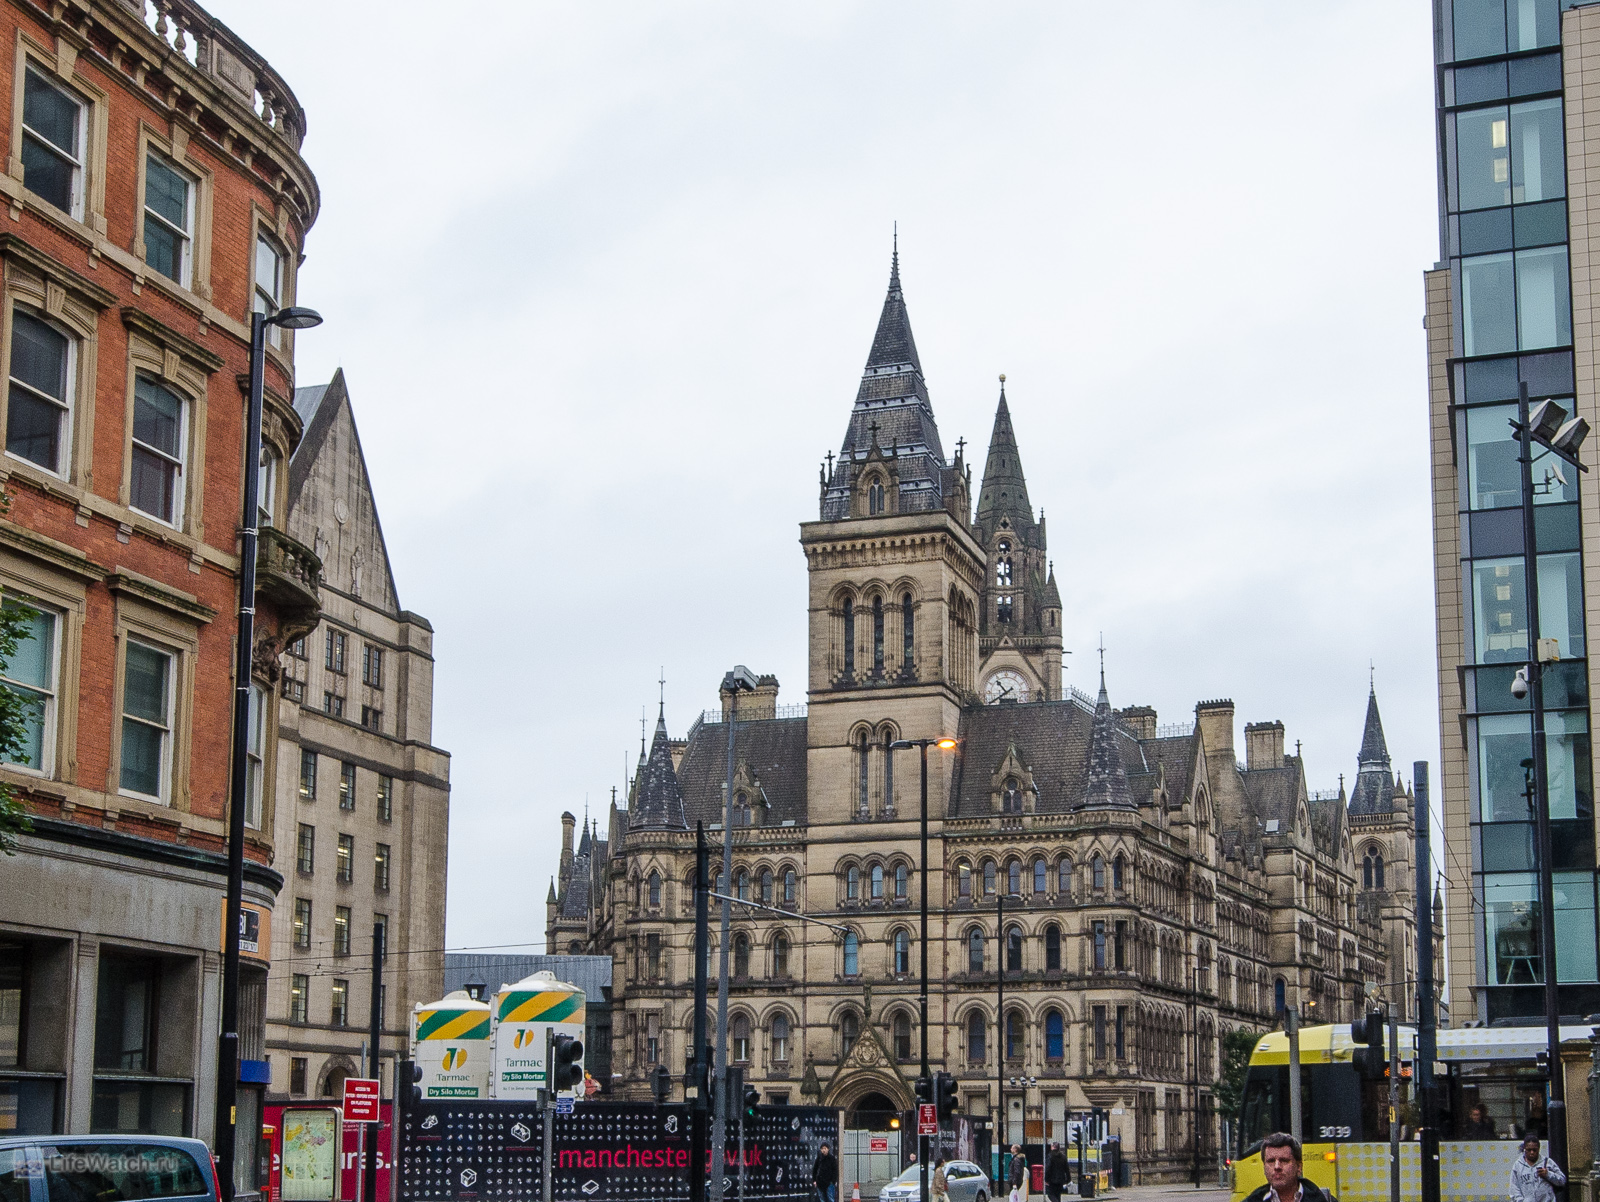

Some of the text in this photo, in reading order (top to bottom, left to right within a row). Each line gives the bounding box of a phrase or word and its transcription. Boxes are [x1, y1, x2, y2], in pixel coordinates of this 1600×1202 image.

[505, 1058, 543, 1067] Tarmac
[436, 1073, 471, 1082] Tarmac
[429, 1089, 440, 1097] Dry
[455, 1088, 477, 1096] Mortar
[1320, 1126, 1351, 1138] 3039
[559, 1144, 763, 1174] manchestergv.uk
